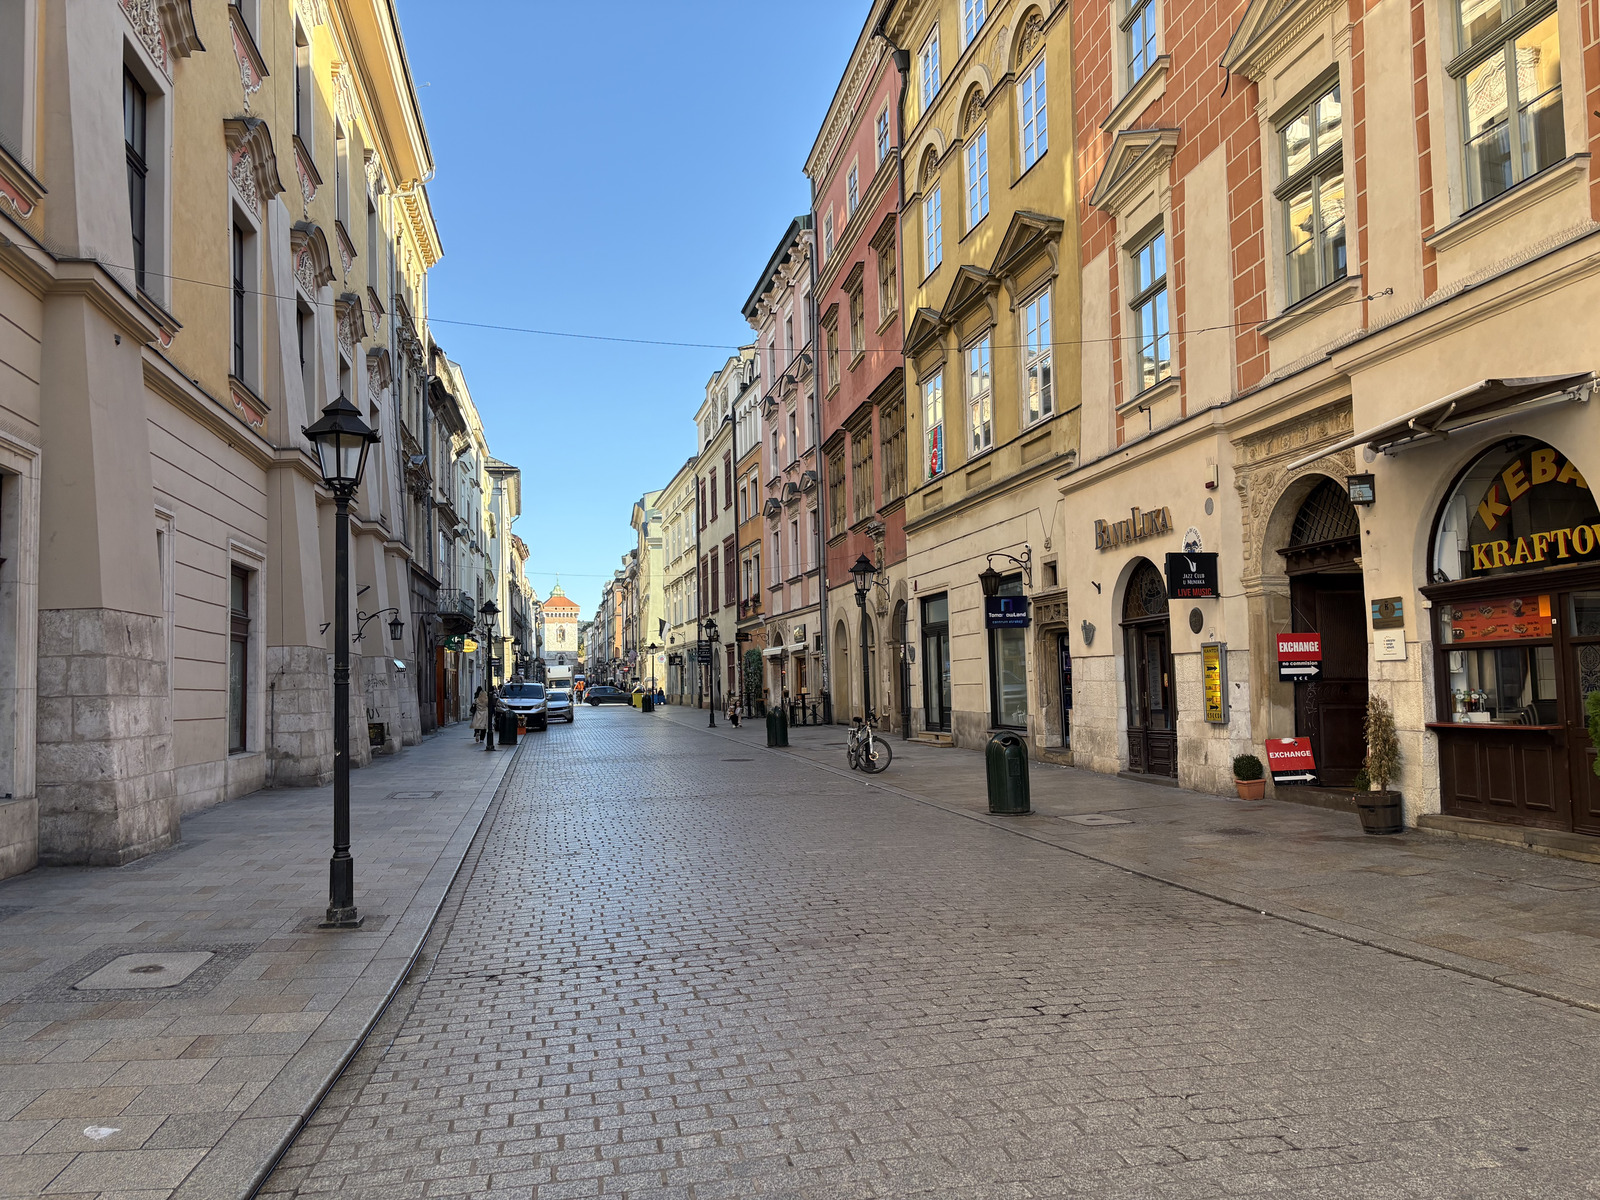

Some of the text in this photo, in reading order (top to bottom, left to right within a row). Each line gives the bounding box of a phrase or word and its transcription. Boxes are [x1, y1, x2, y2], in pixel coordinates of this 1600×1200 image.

[1177, 587, 1212, 597] LIVE MUSIC
[1279, 641, 1320, 653] EXCHANGE
[1269, 750, 1312, 759] EXCHANGE
